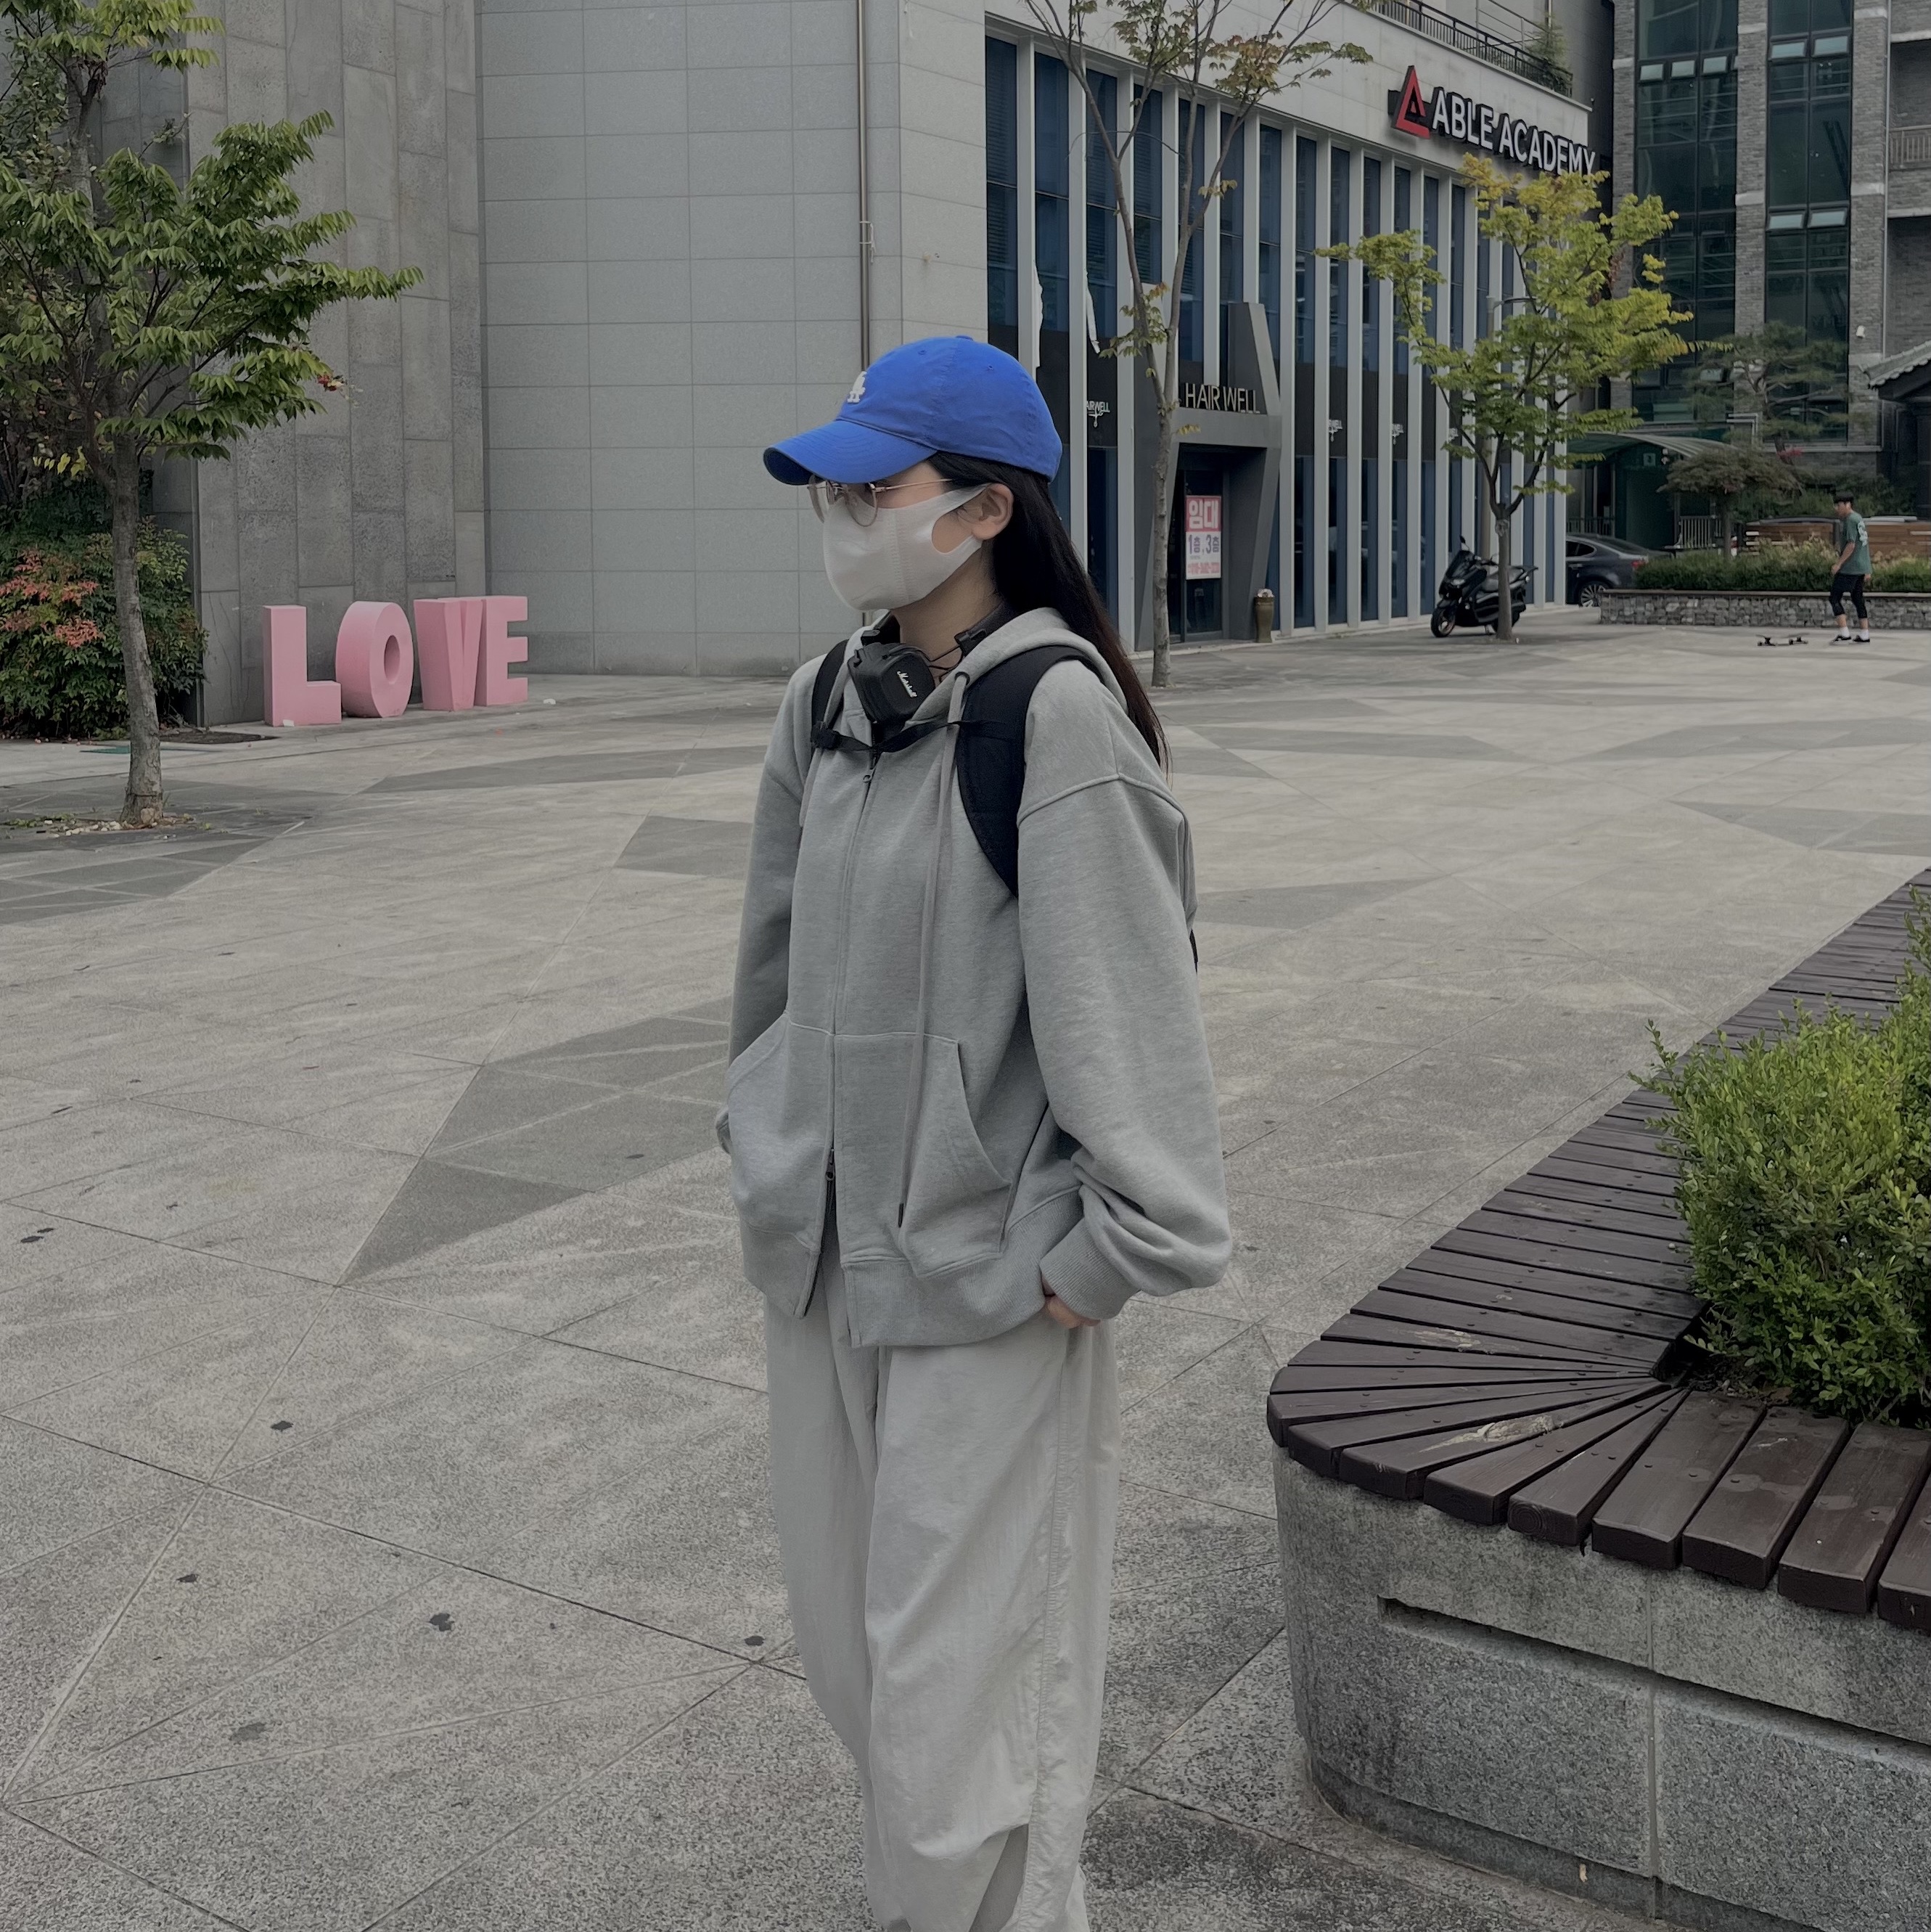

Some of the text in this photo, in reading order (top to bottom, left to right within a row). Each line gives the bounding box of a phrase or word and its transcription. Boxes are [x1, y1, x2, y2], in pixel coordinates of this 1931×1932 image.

[1432, 89, 1596, 176] ABLE ACADEMY
[1185, 382, 1260, 414] HAIR WELL
[1189, 500, 1219, 530] 임대
[263, 596, 528, 726] LOVE
[896, 671, 918, 697] Marshall
